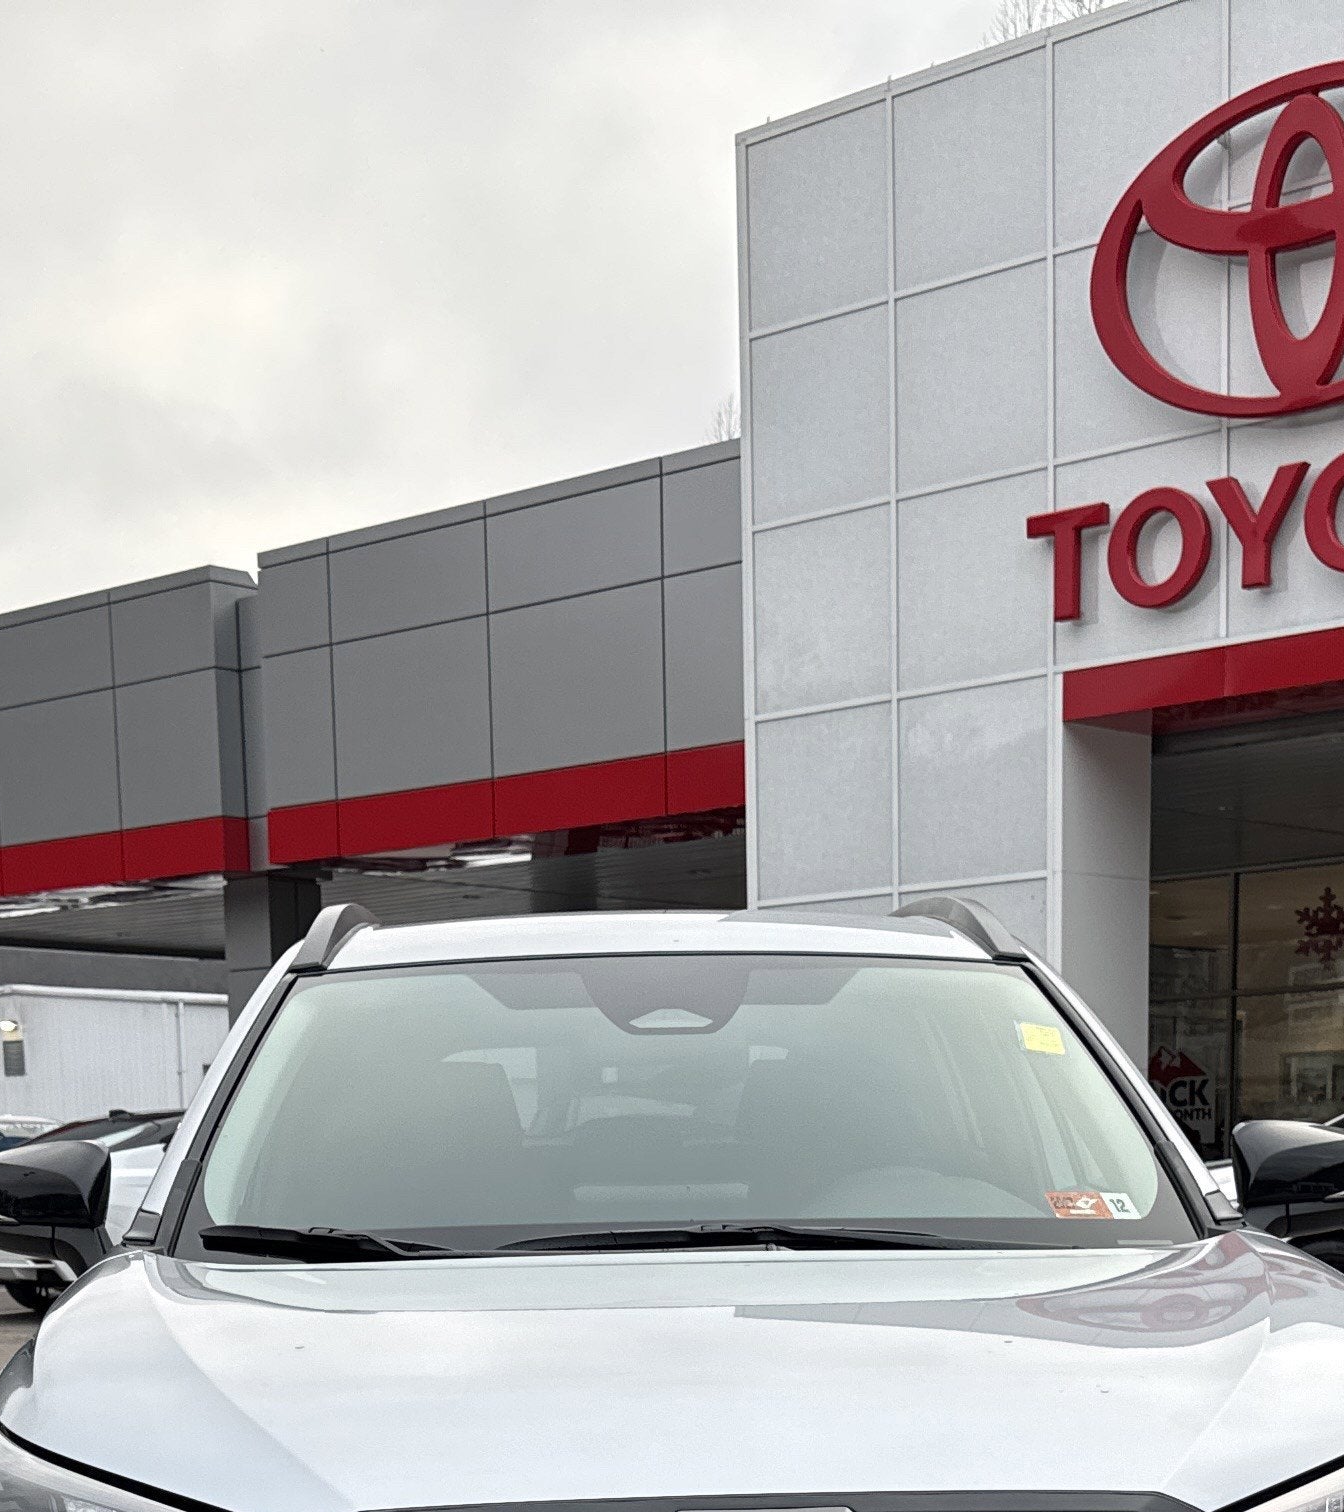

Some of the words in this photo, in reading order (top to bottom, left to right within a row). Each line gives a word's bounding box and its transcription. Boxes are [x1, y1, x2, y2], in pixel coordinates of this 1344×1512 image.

[1156, 1079, 1210, 1107] CK
[1172, 1107, 1213, 1120] ONTH
[1109, 1198, 1131, 1213] 12
